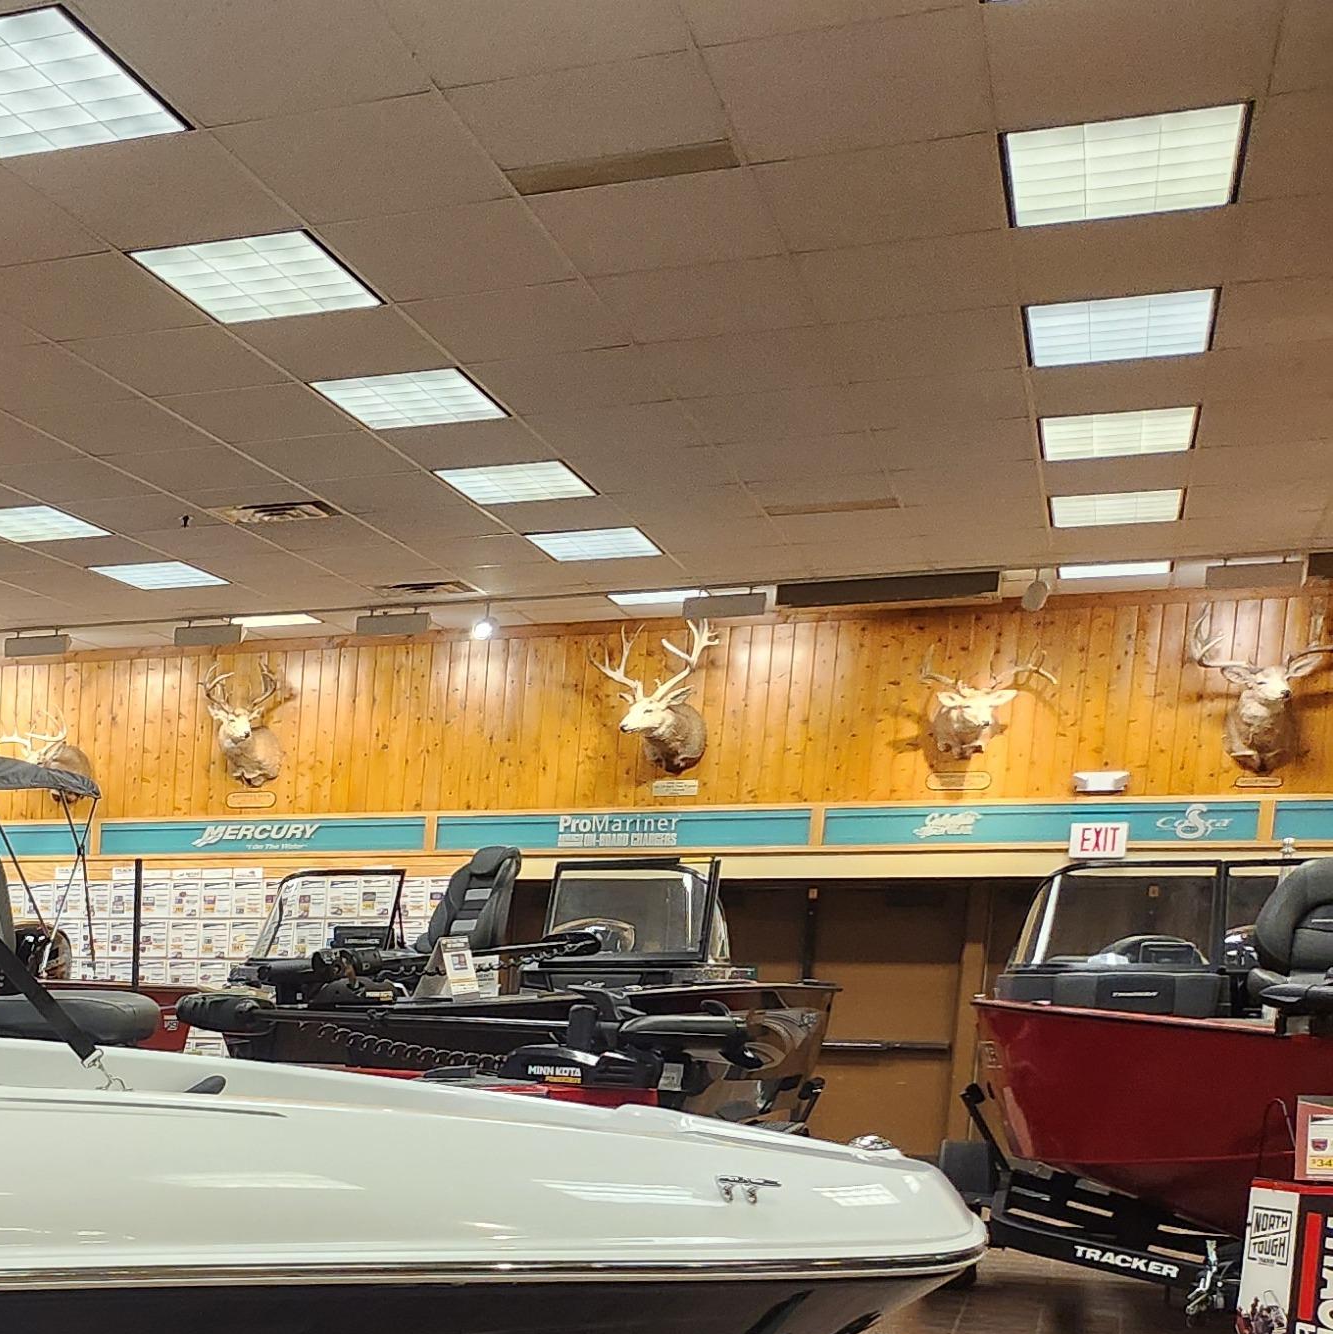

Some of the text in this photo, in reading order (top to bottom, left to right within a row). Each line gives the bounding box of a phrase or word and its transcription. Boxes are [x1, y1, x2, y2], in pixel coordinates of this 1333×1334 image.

[559, 815, 679, 833] ProMariner
[191, 823, 321, 848] MERCURY
[1080, 827, 1121, 852] EXIT
[527, 1065, 582, 1077] MINN KOTA
[1254, 1211, 1289, 1233] NORTH
[1252, 1236, 1287, 1258] TOUGH
[1073, 1245, 1180, 1279] TRACKER
